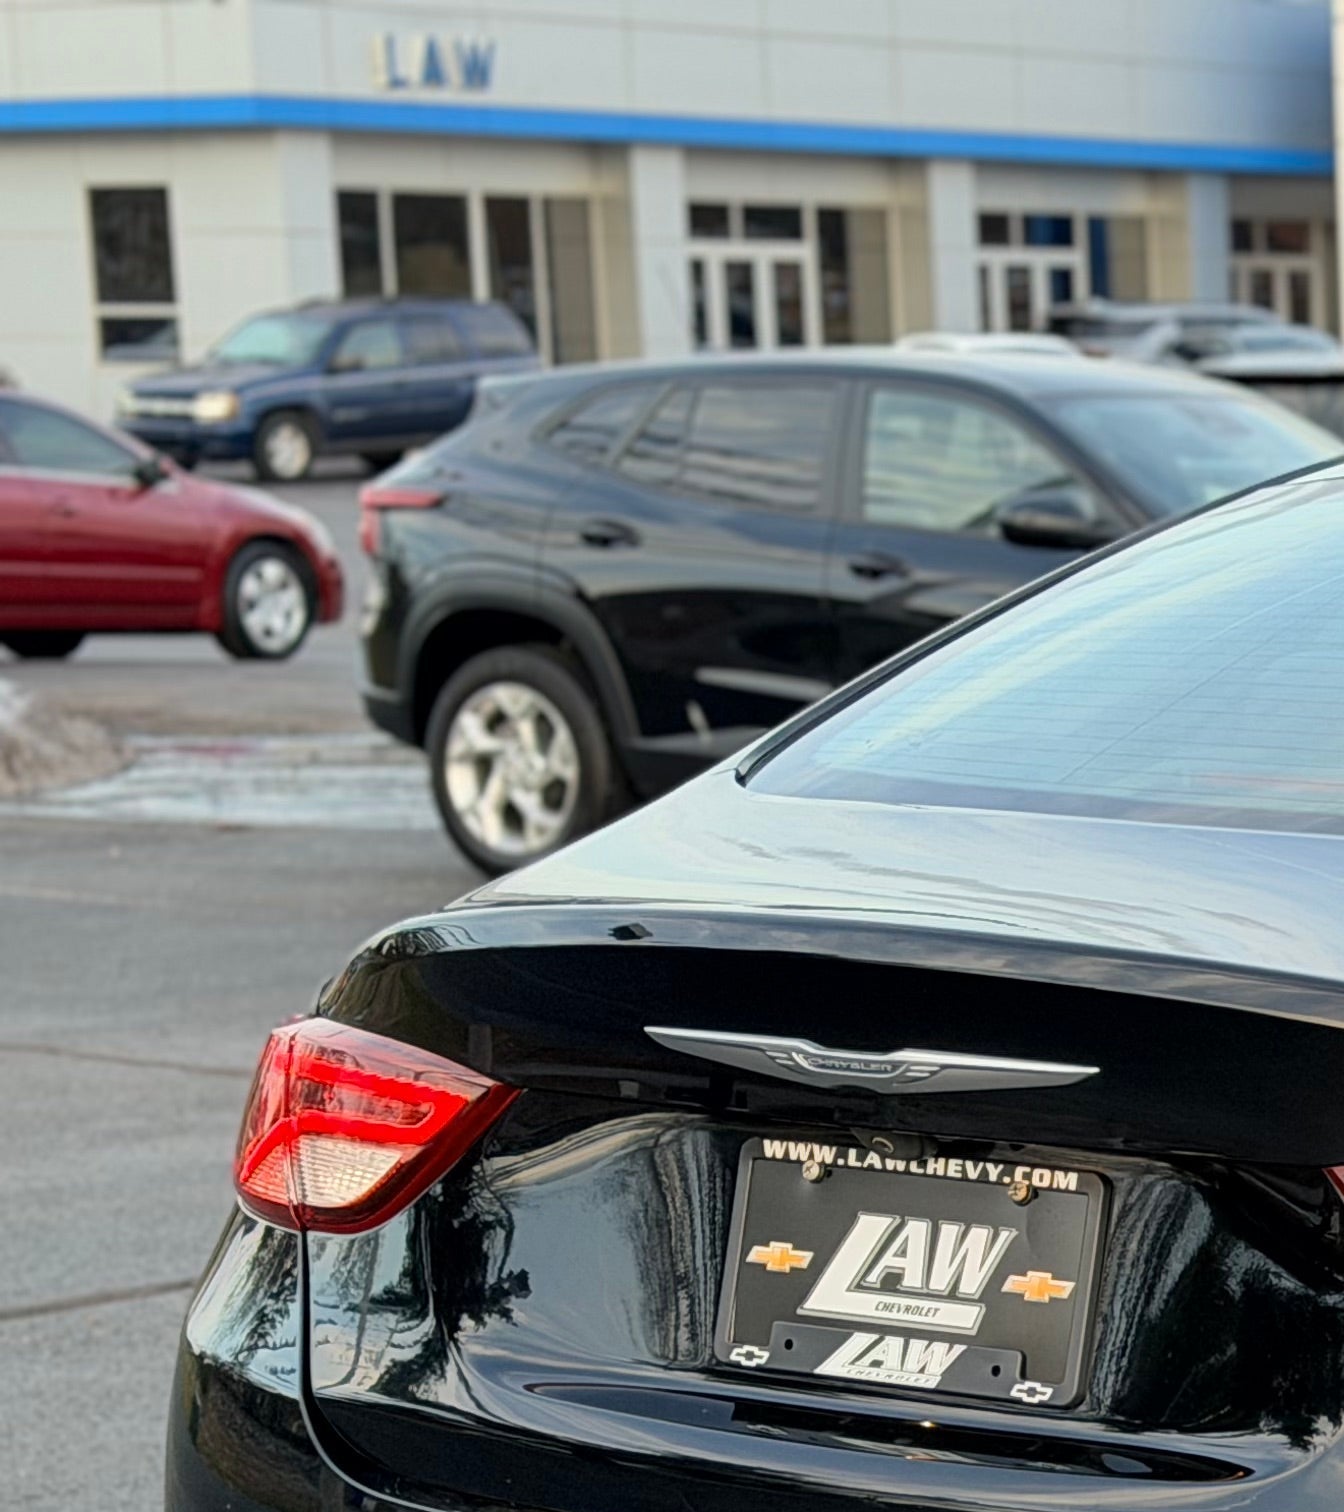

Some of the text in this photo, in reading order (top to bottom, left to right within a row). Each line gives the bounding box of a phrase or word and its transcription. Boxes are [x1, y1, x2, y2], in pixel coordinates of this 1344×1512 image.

[370, 31, 498, 89] LAW
[762, 1138, 1079, 1192] WWW.LAWCHEVY.COM
[796, 1211, 1019, 1336] LAW
[874, 1300, 941, 1319] CHEVROLET
[813, 1331, 969, 1389] LAW
